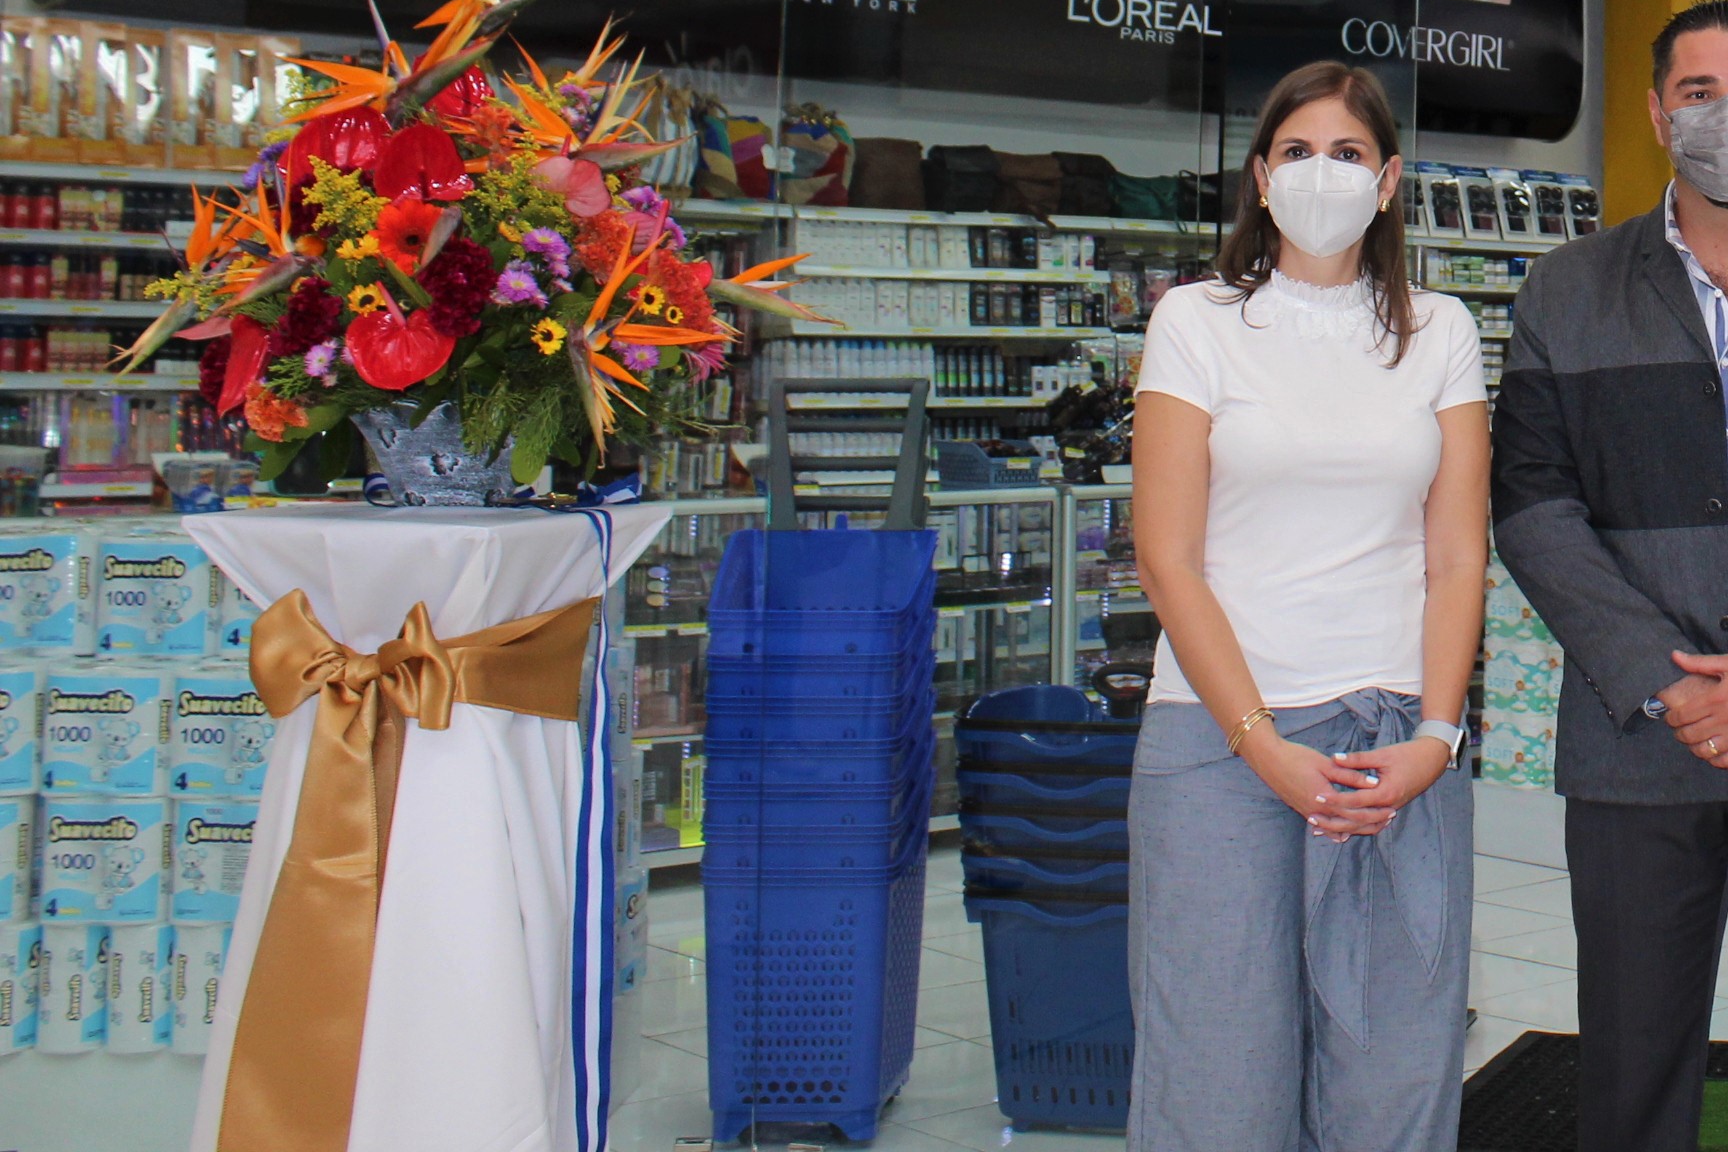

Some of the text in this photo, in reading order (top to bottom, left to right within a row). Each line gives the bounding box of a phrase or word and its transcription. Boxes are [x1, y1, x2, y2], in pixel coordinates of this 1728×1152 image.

[1119, 26, 1176, 45] PARIS
[1341, 17, 1511, 71] COVERGIRL
[103, 555, 186, 581] Suavecito
[105, 590, 147, 606] 1000
[49, 688, 134, 715] Suavecito
[177, 690, 269, 717] Suavecito
[50, 726, 92, 742] 1000
[180, 728, 225, 744] 1000
[50, 816, 138, 842] Suavecito
[186, 817, 256, 844] Suavec
[52, 854, 96, 870] 1000
